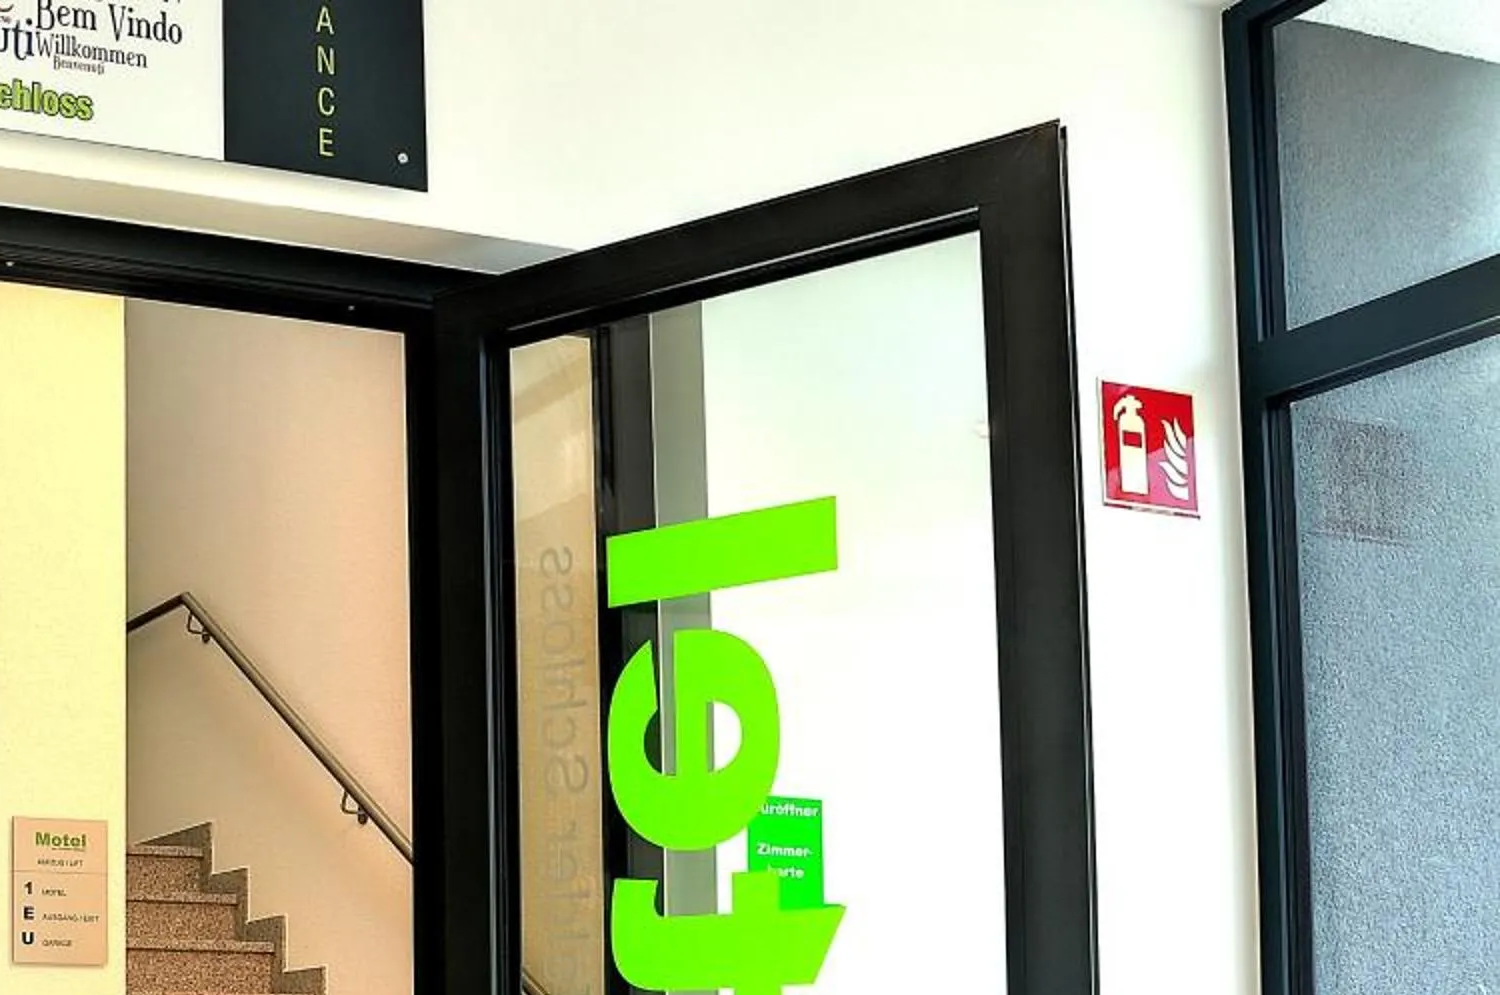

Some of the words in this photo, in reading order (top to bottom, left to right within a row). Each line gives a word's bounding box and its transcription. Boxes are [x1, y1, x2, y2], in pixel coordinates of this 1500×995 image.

[36, 0, 97, 31] Bem
[108, 3, 183, 44] Vindo
[35, 31, 148, 68] Willkommen
[35, 831, 87, 848] Motel
[24, 881, 33, 895] 1
[23, 906, 35, 920] E
[21, 931, 35, 945] U
